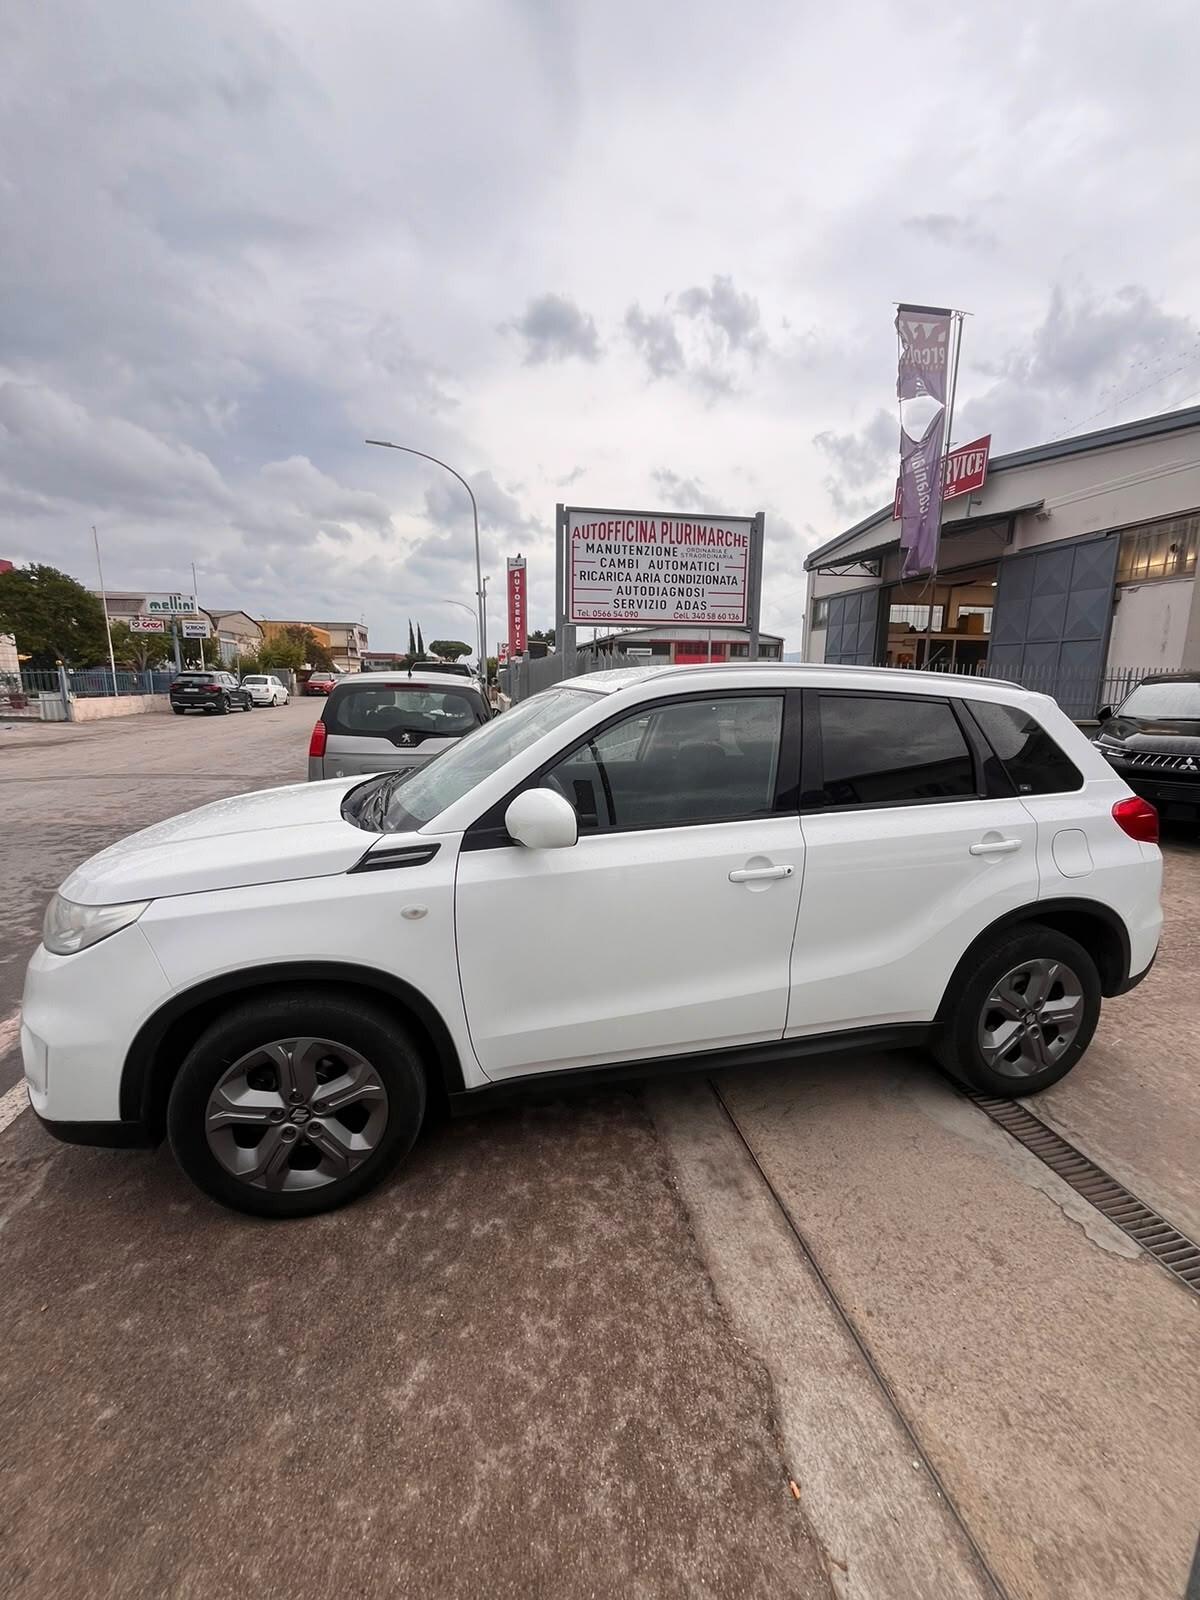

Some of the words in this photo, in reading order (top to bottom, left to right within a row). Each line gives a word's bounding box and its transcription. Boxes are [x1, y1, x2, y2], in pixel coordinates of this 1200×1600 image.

[572, 520, 657, 543] AUTOFFICINA
[661, 521, 748, 548] PLURIMARCHE
[586, 543, 678, 557] MANUTENZIONE
[680, 552, 733, 560] STRAORDINARIA
[600, 557, 639, 569] CAMBI
[648, 559, 720, 571] AUTOMATICI
[580, 570, 632, 582] RICARICA
[635, 572, 661, 583] ARIA
[663, 573, 738, 586] CONDIZIONATA
[616, 585, 705, 597] AUTODIAGNOSI
[150, 596, 194, 609] mellini
[613, 598, 667, 610] SERVIZIO
[675, 600, 708, 611] ADAS
[592, 610, 612, 618] 0566
[624, 610, 639, 618] 090
[692, 612, 706, 620] 340
[706, 612, 716, 620] 58
